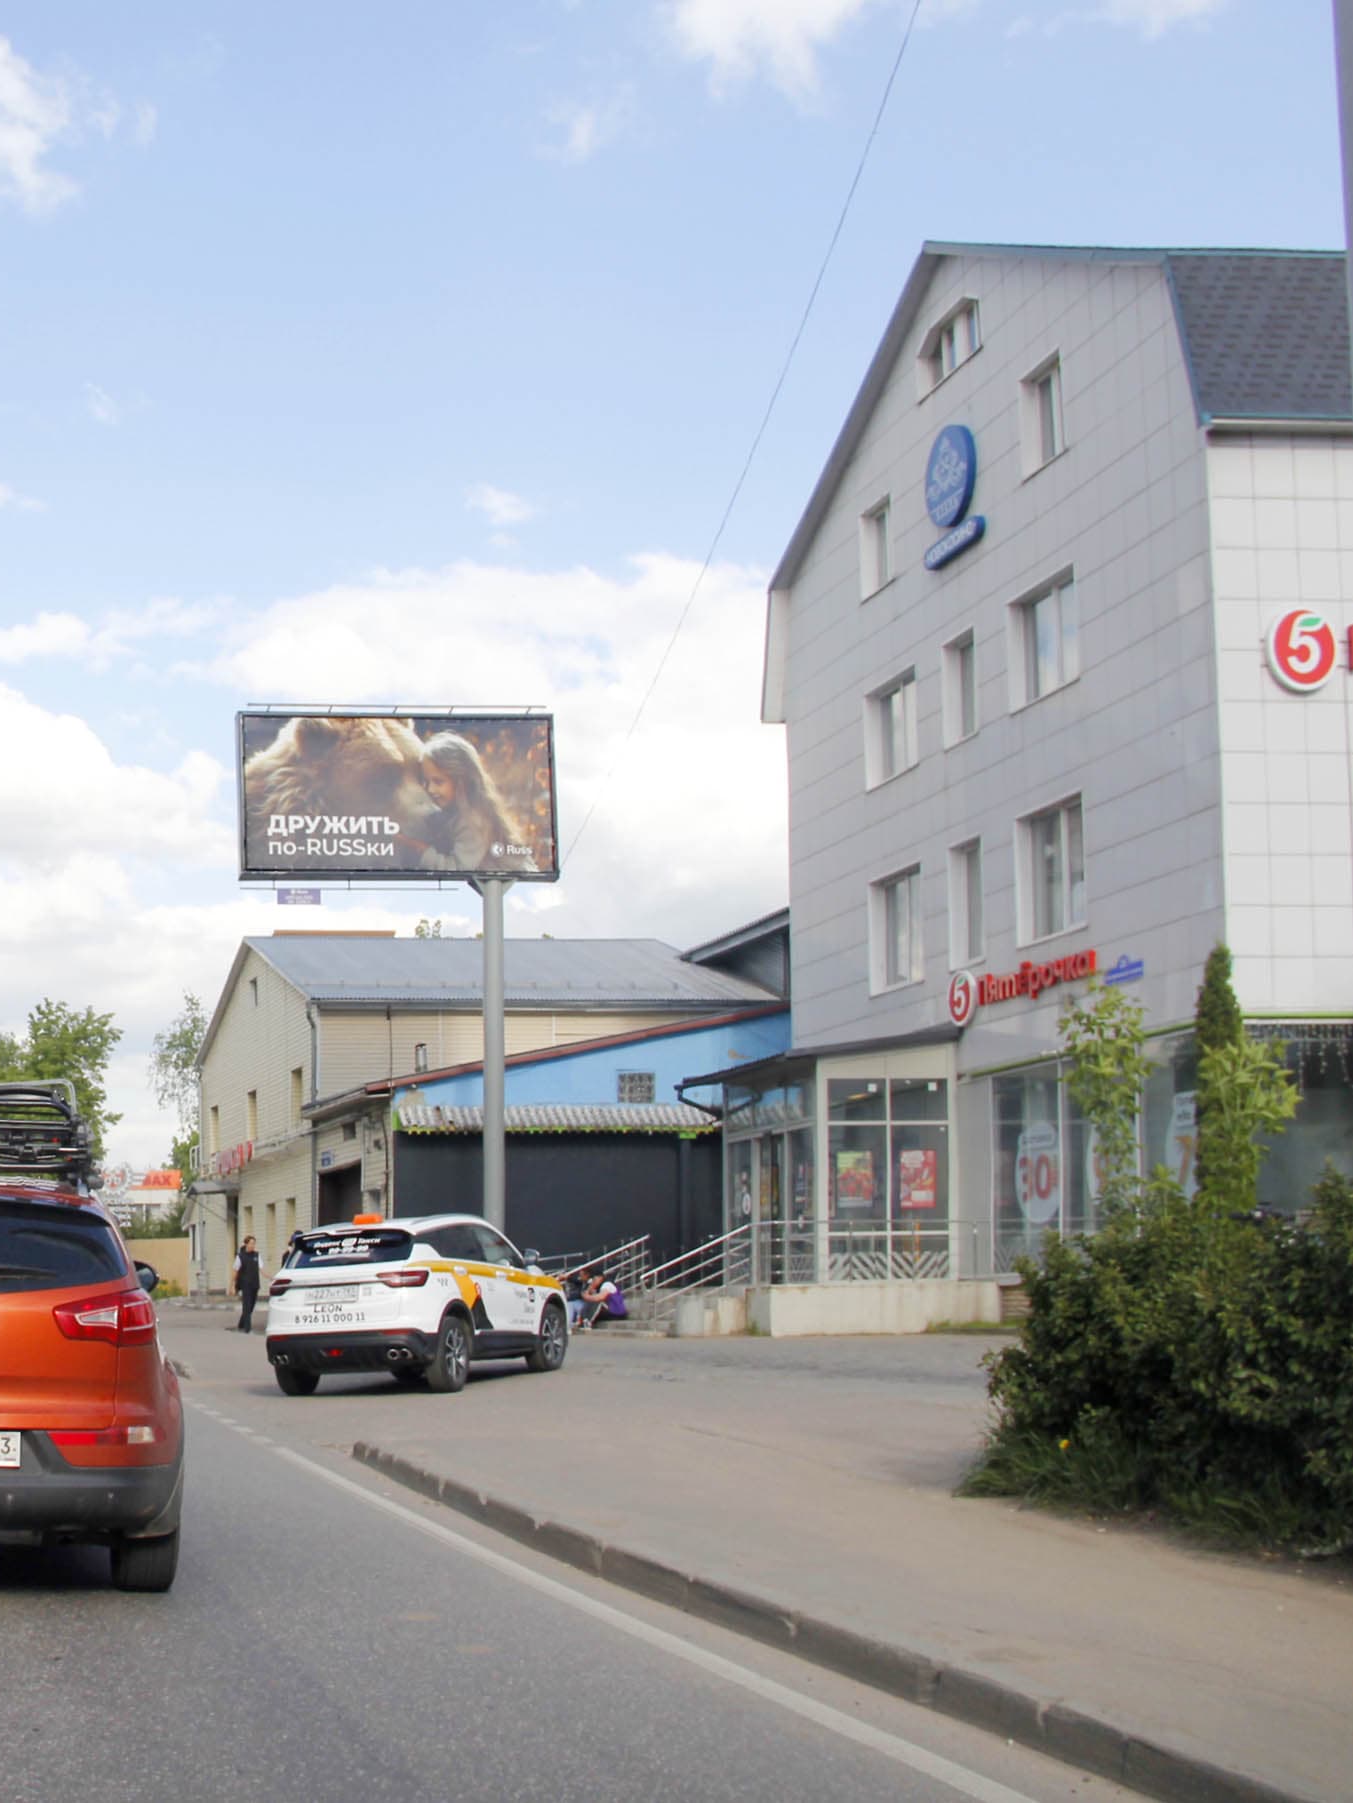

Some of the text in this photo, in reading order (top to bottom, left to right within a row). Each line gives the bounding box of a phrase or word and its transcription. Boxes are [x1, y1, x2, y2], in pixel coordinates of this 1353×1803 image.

[267, 814, 401, 837] ДРУЖИТЬ
[268, 838, 395, 856] по-RUSSки
[977, 949, 1096, 1006] Пятёрочка
[313, 1303, 343, 1314] LEON
